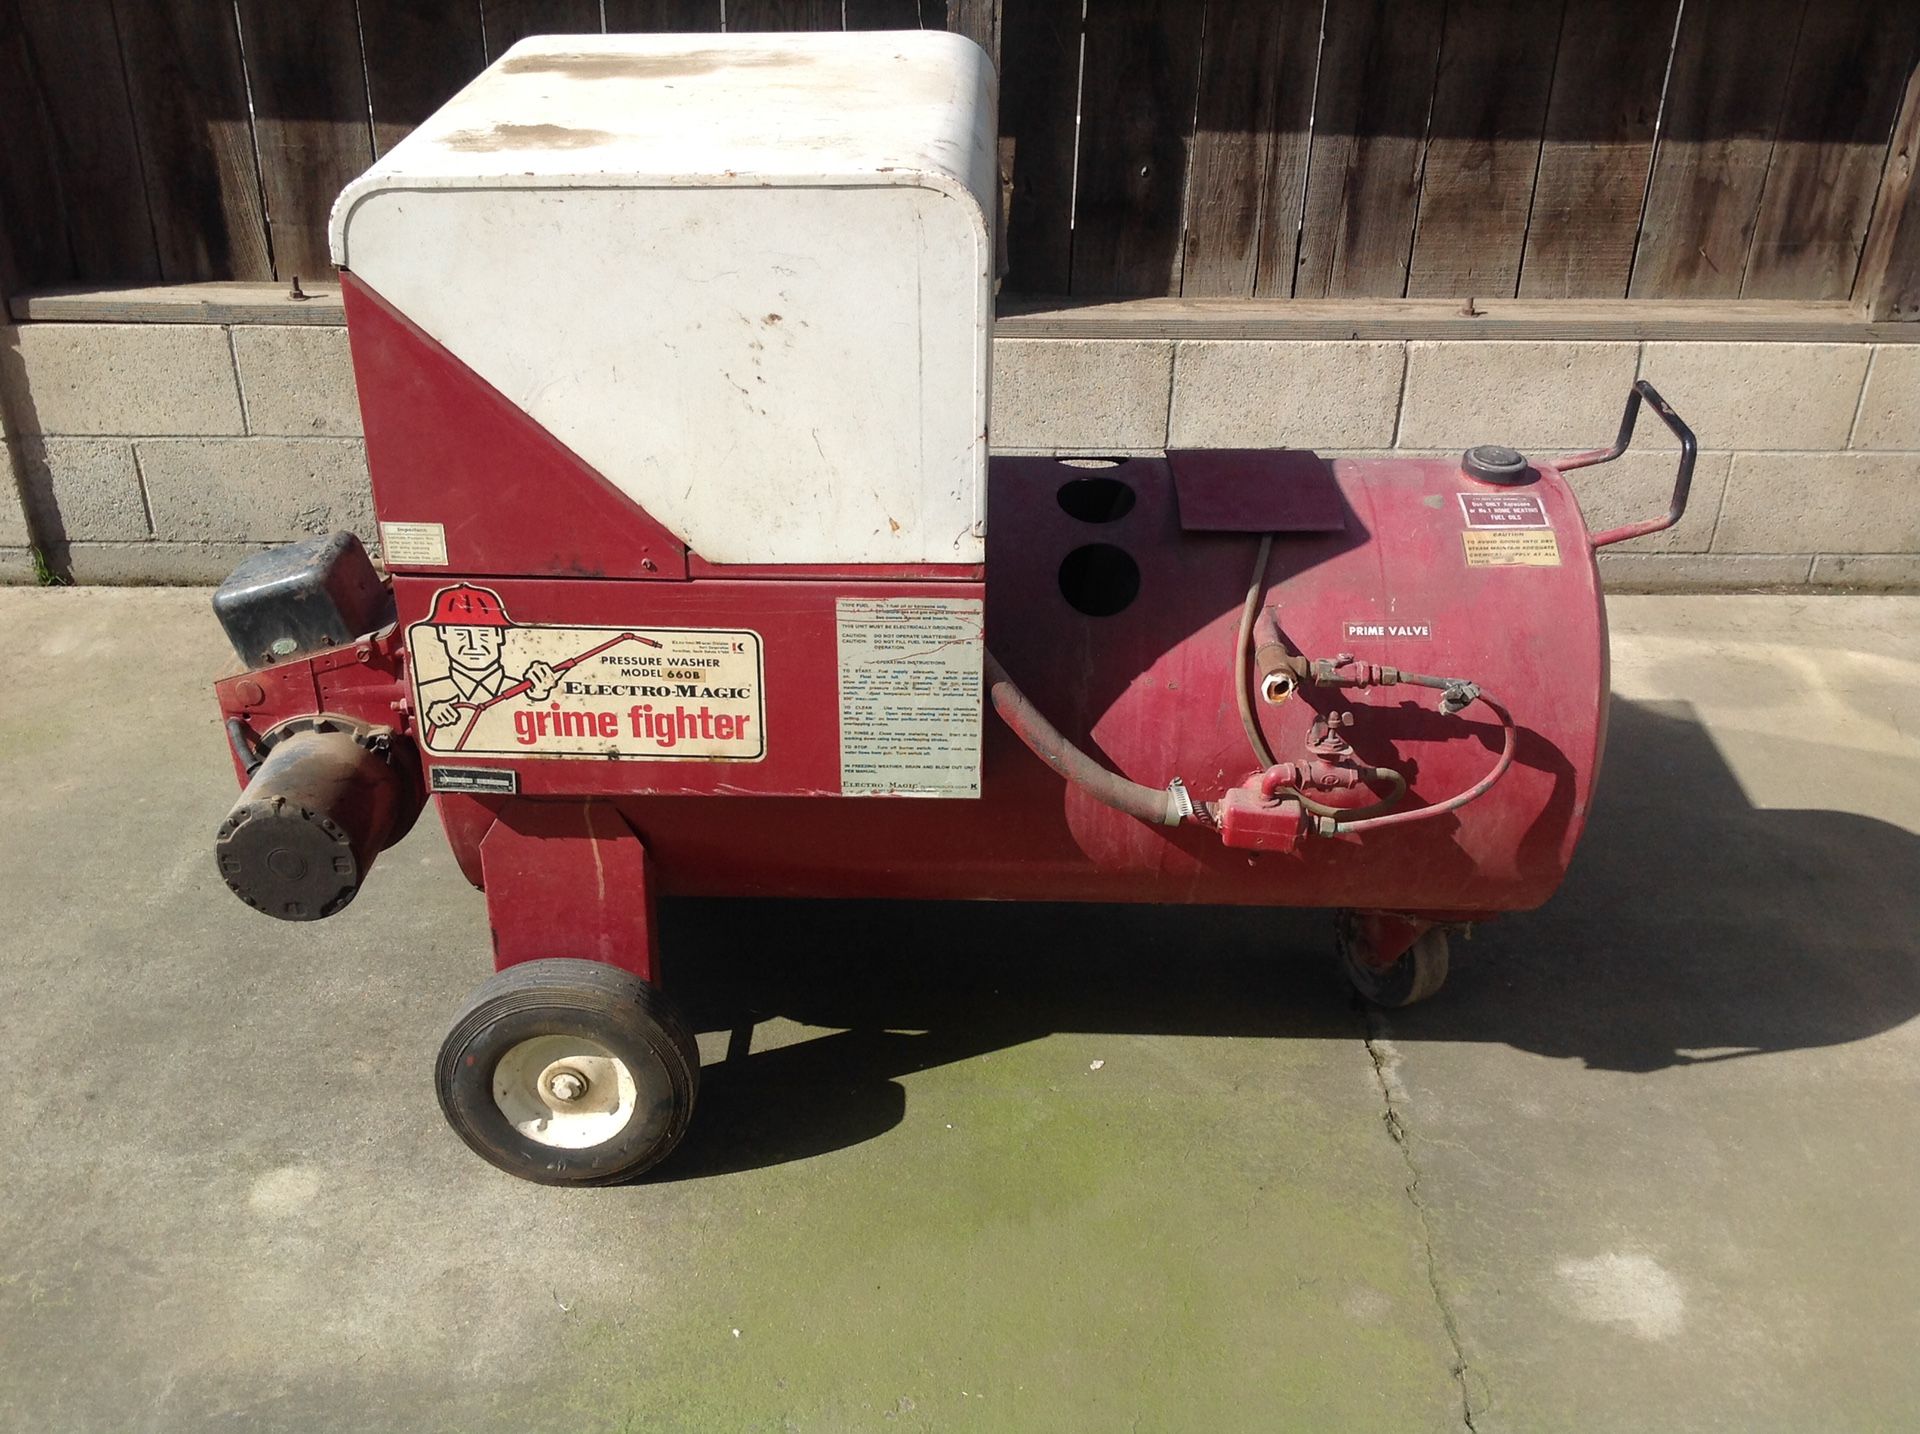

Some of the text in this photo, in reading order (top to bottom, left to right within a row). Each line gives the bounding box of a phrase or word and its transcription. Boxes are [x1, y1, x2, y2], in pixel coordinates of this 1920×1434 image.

[1348, 626, 1429, 636] PRIME VALVE
[601, 656, 720, 668] PRESSURE WASHER
[620, 668, 700, 680] MODEL 660B
[514, 702, 750, 748] grime fighter
